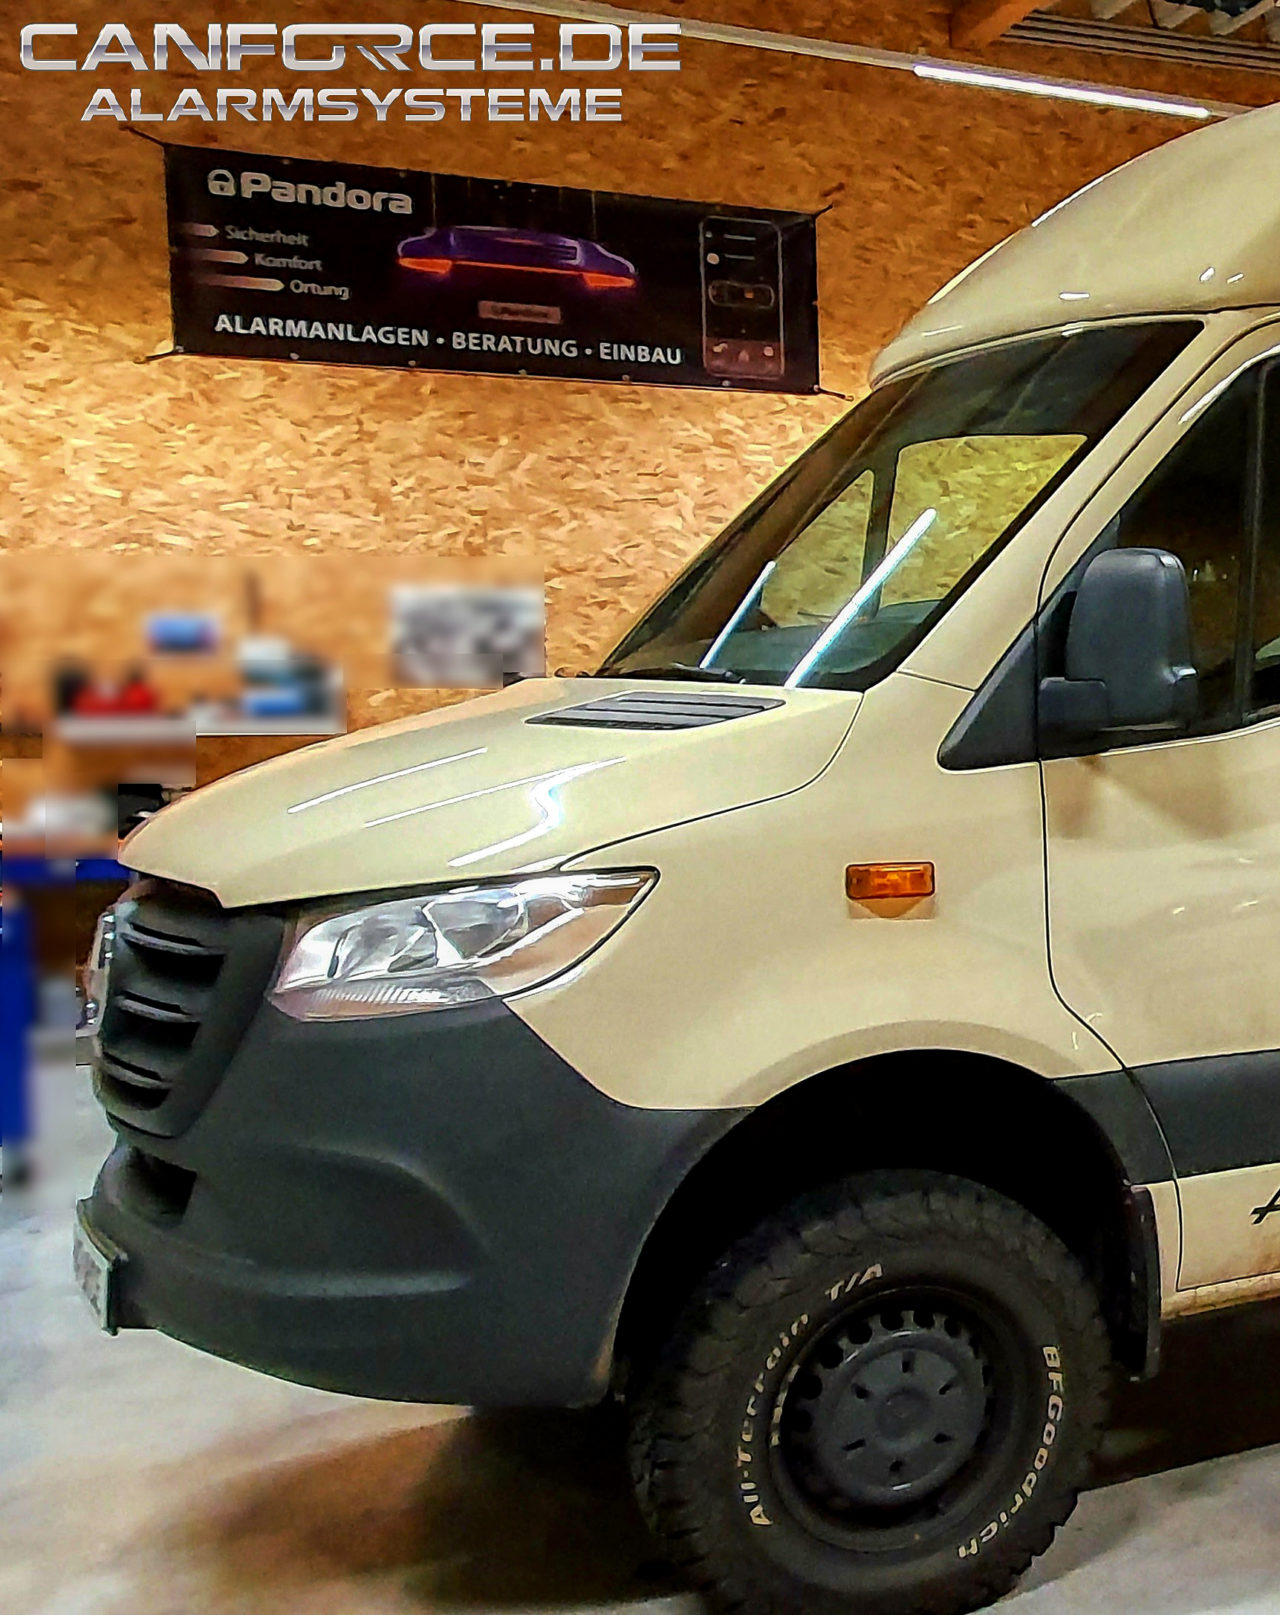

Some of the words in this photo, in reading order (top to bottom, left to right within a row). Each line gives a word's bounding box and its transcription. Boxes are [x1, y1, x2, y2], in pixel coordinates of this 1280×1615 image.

[239, 170, 413, 214] Pandora
[225, 224, 310, 247] Sicherheit
[254, 252, 322, 272] Komfort
[289, 279, 350, 301] Ortung
[213, 312, 429, 348] ALARMANLAGEN
[451, 331, 579, 358] BERATUNG
[600, 341, 682, 366] EINBAU
[824, 1262, 884, 1302] T/A
[957, 1345, 1065, 1559] BFGoodrich
